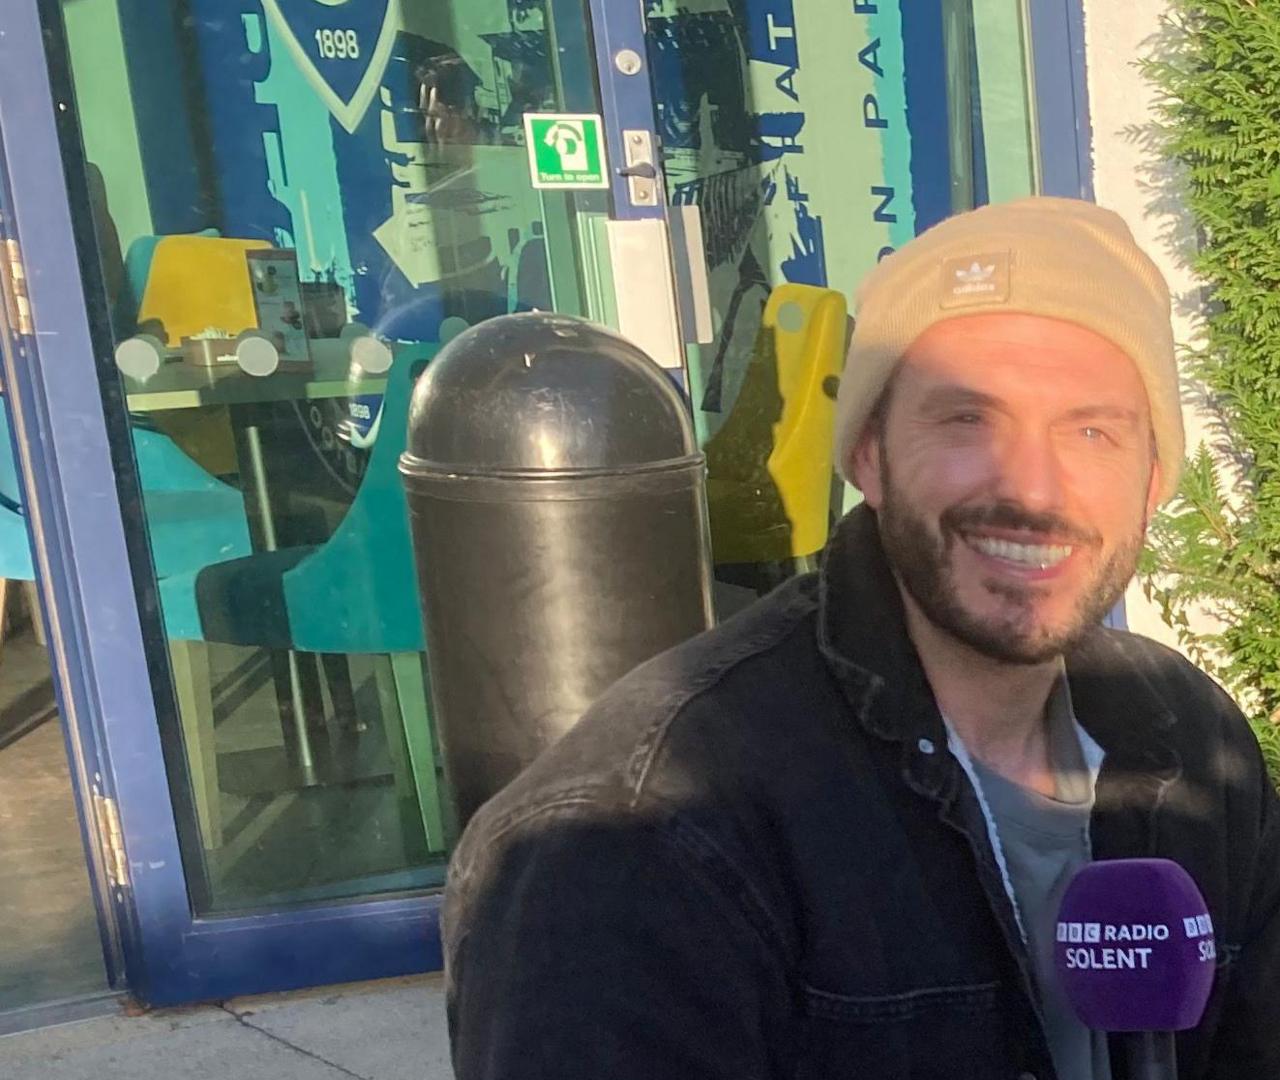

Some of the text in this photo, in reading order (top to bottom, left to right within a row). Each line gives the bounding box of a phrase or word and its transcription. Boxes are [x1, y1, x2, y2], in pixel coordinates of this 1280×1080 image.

[314, 28, 360, 59] 1898
[539, 172, 562, 182] Turn
[575, 173, 601, 184] open
[1056, 922, 1169, 943] BBC RADIO
[1066, 947, 1152, 970] SOLENT
